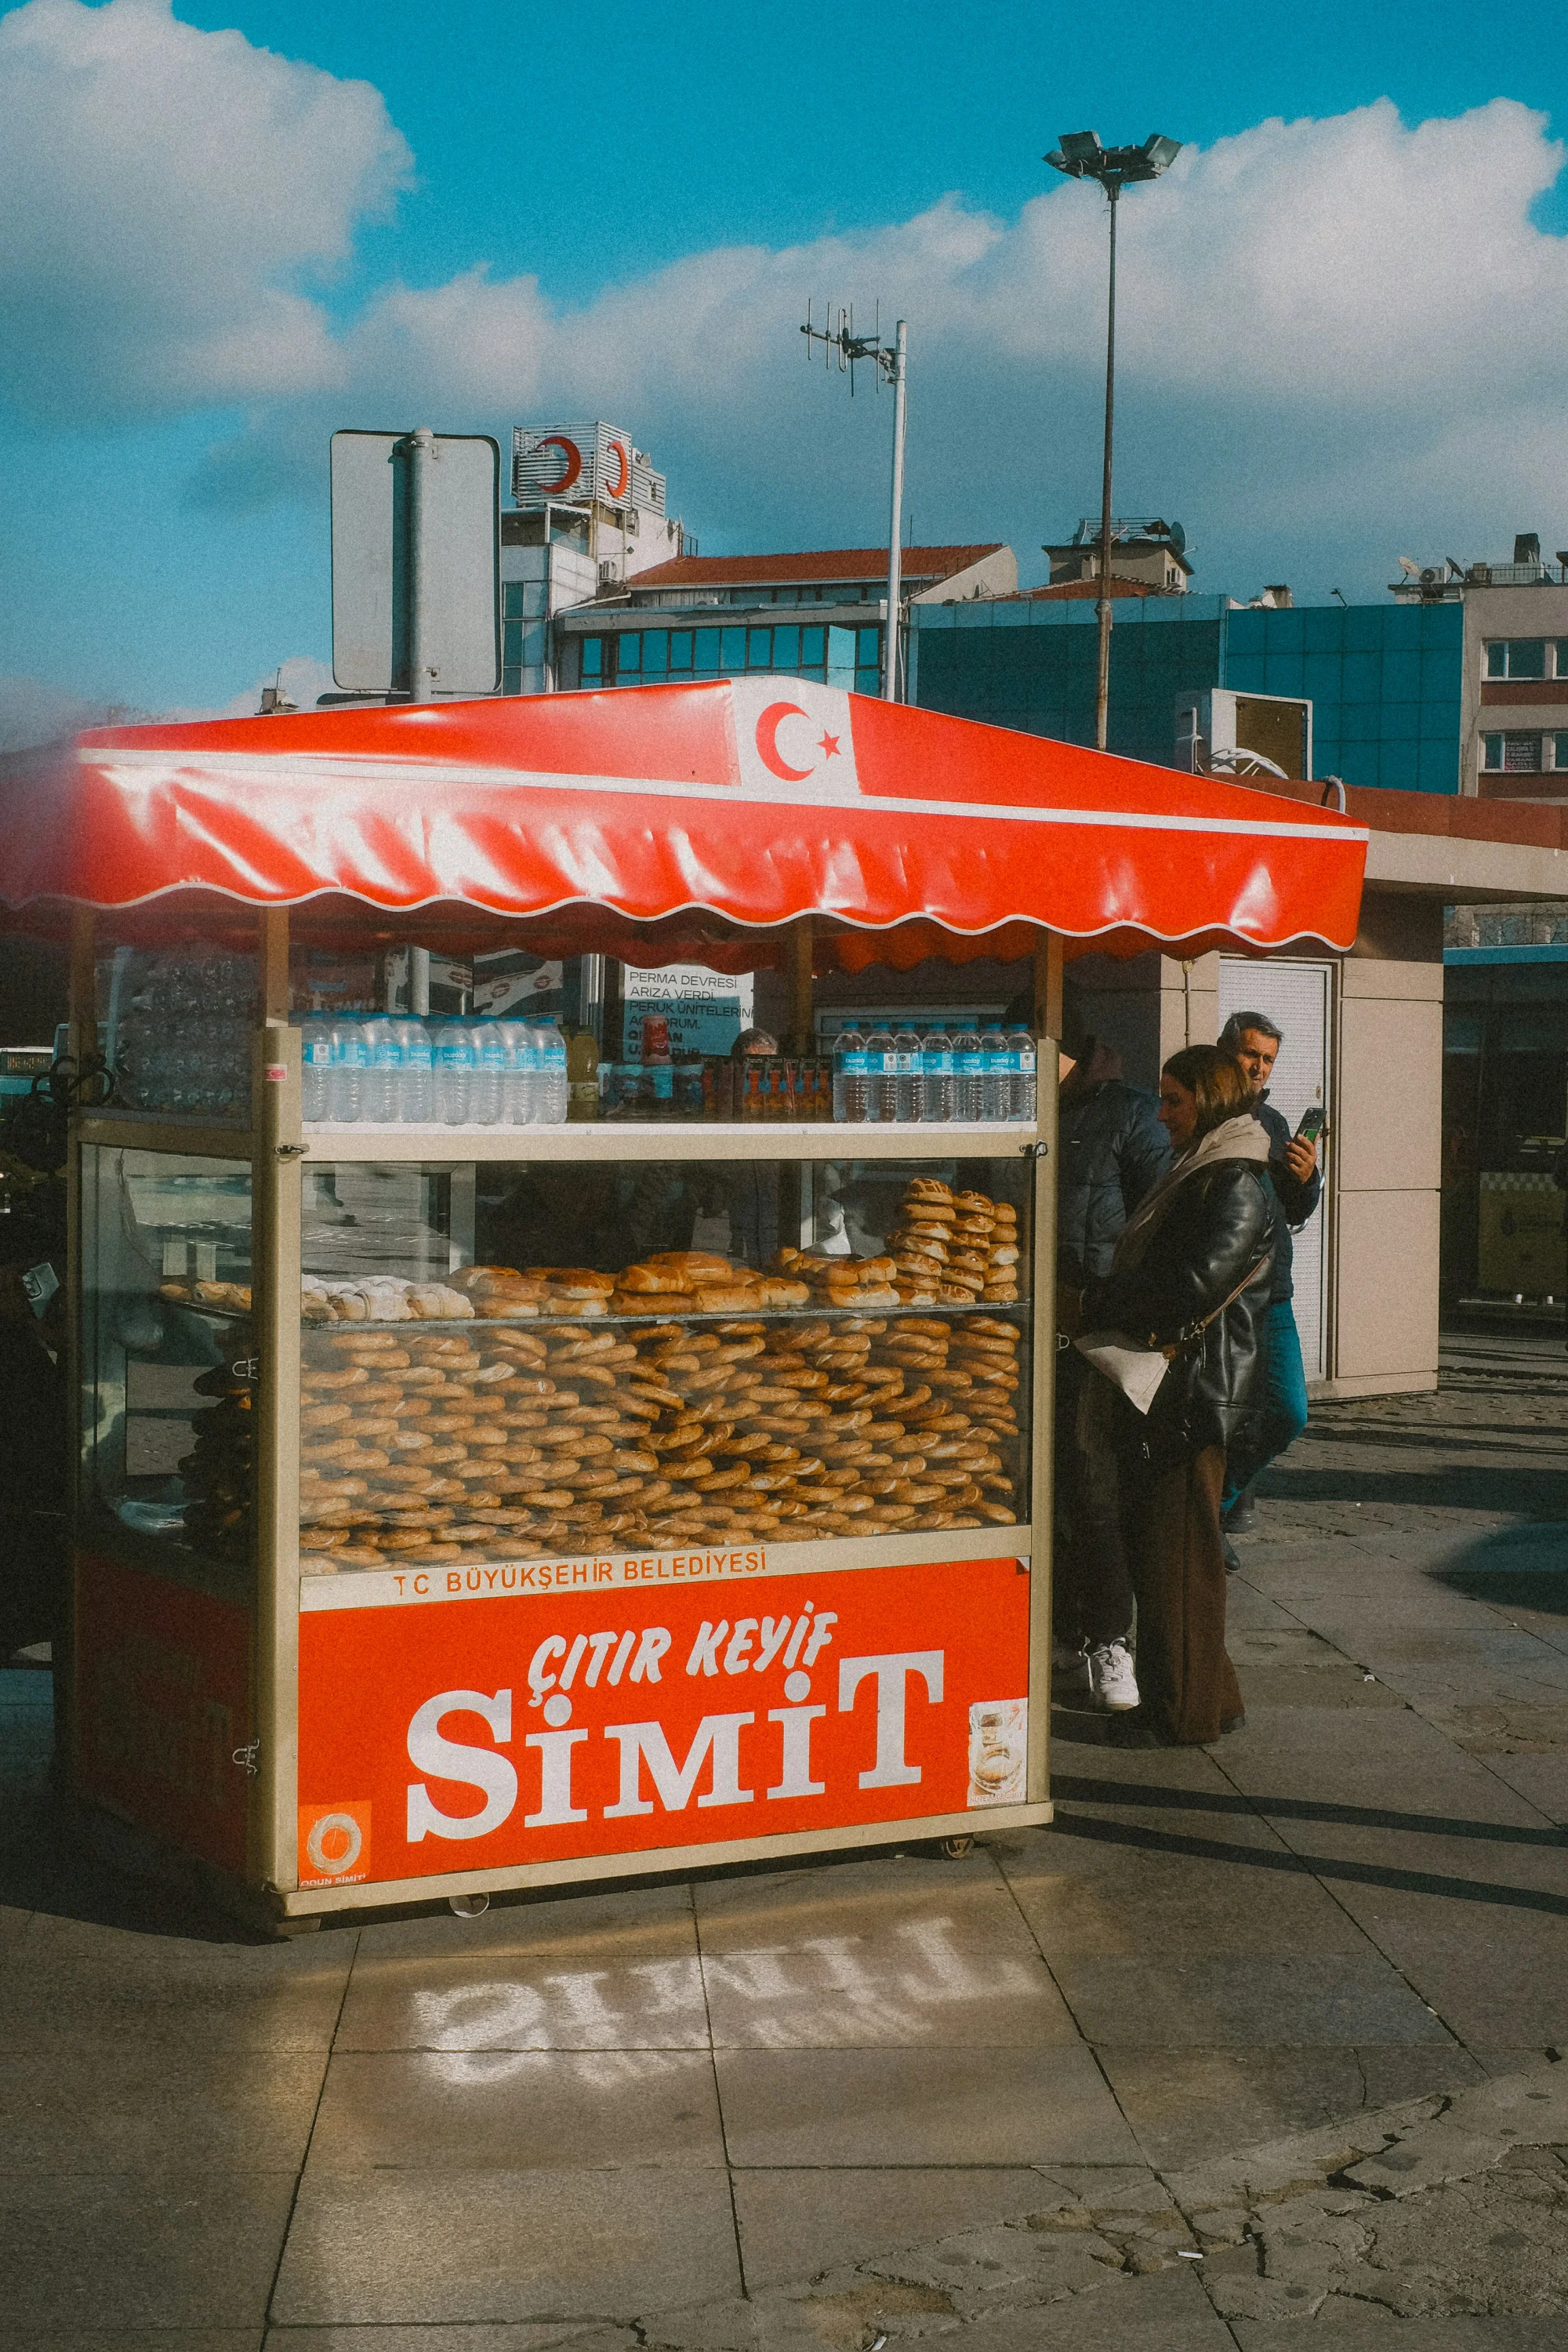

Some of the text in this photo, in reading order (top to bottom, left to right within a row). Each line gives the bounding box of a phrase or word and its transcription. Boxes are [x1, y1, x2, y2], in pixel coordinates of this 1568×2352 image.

[630, 972, 737, 989] PERMA DEVRESİ
[630, 987, 717, 1002] ARIZA VERDİ.
[630, 1001, 674, 1014] PERUK
[447, 1558, 613, 1592] BÜYÜKŞEHİR
[624, 1546, 766, 1580] BELEDİYESİ
[528, 1600, 838, 1708] ÇITIR KEYİF
[407, 1650, 943, 1843] SİMİT
